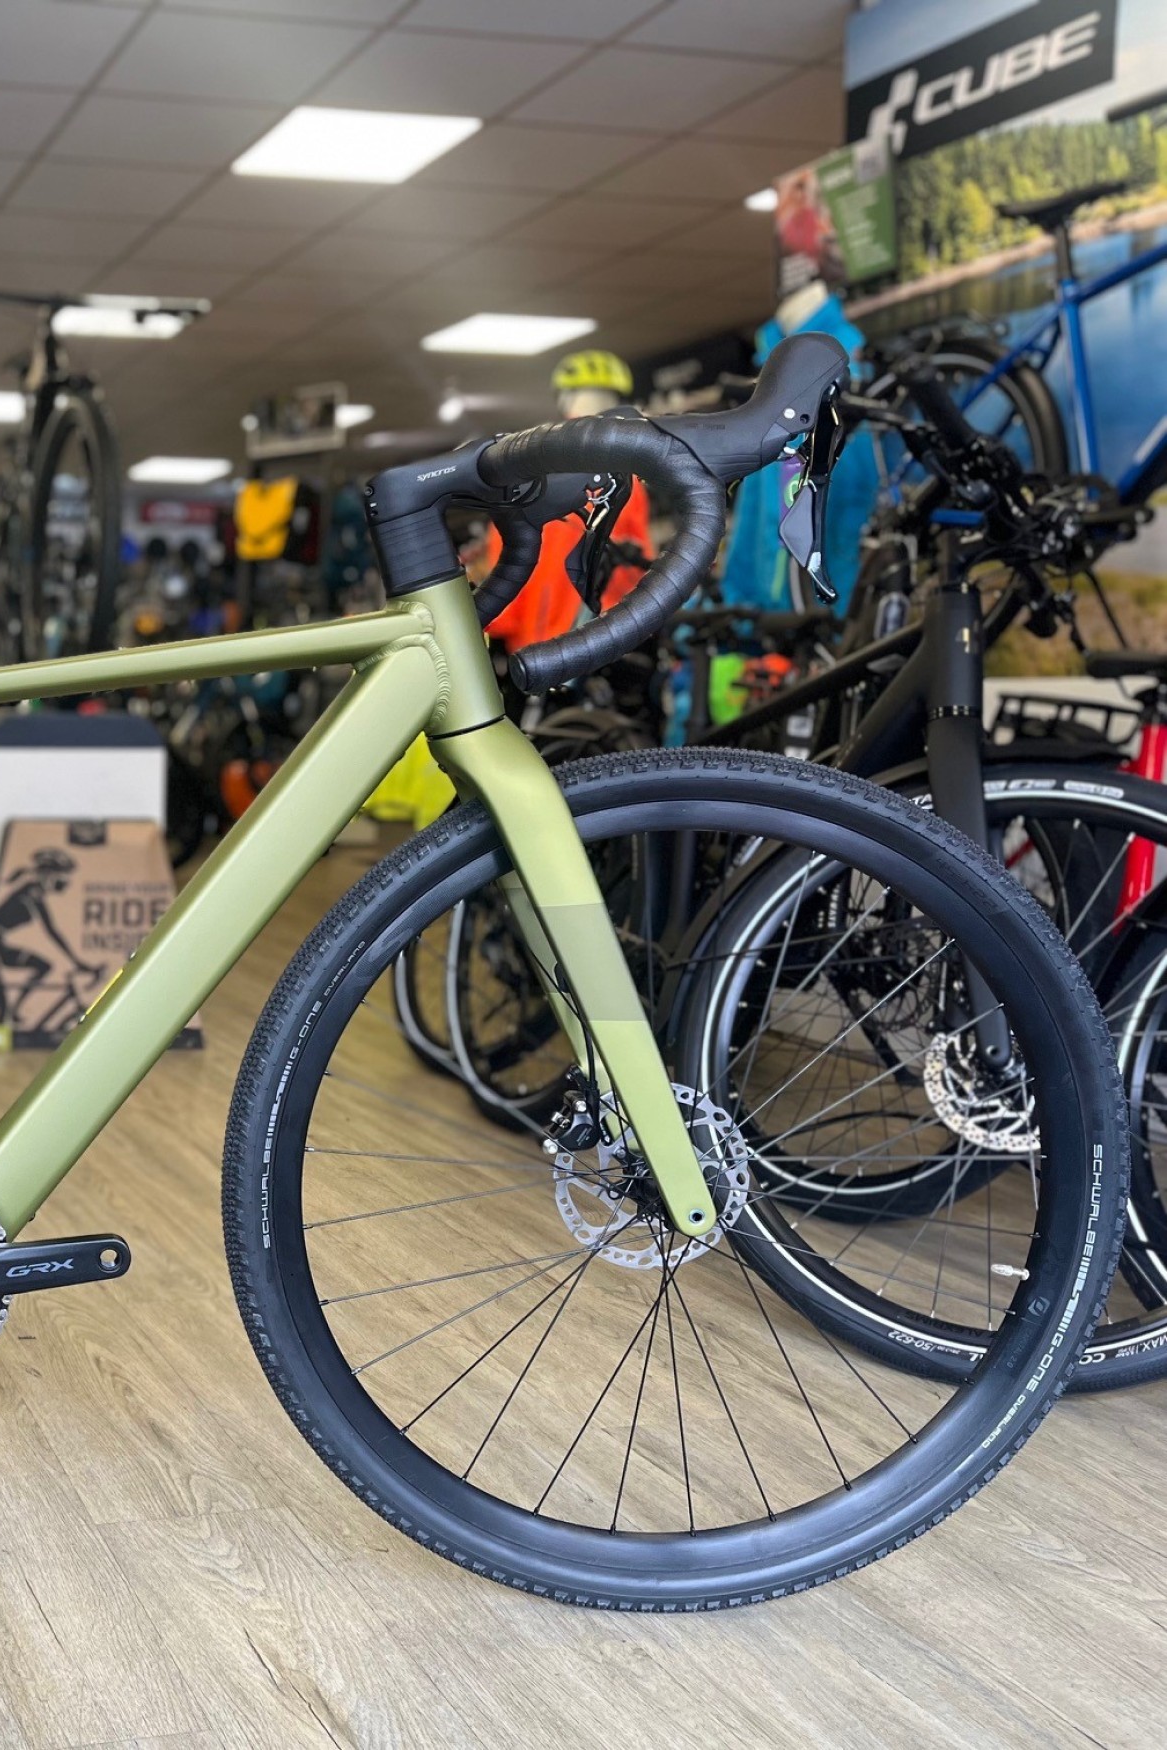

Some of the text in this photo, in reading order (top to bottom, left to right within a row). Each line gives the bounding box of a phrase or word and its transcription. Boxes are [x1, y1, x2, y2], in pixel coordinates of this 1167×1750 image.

[912, 11, 1101, 126] CUBE
[261, 1137, 272, 1250] SCHWALBE
[290, 1000, 323, 1060] G-ONE
[1084, 1144, 1103, 1257] SCHWALBE
[5, 1257, 75, 1278] GRX
[1025, 1332, 1067, 1392] G-ONE
